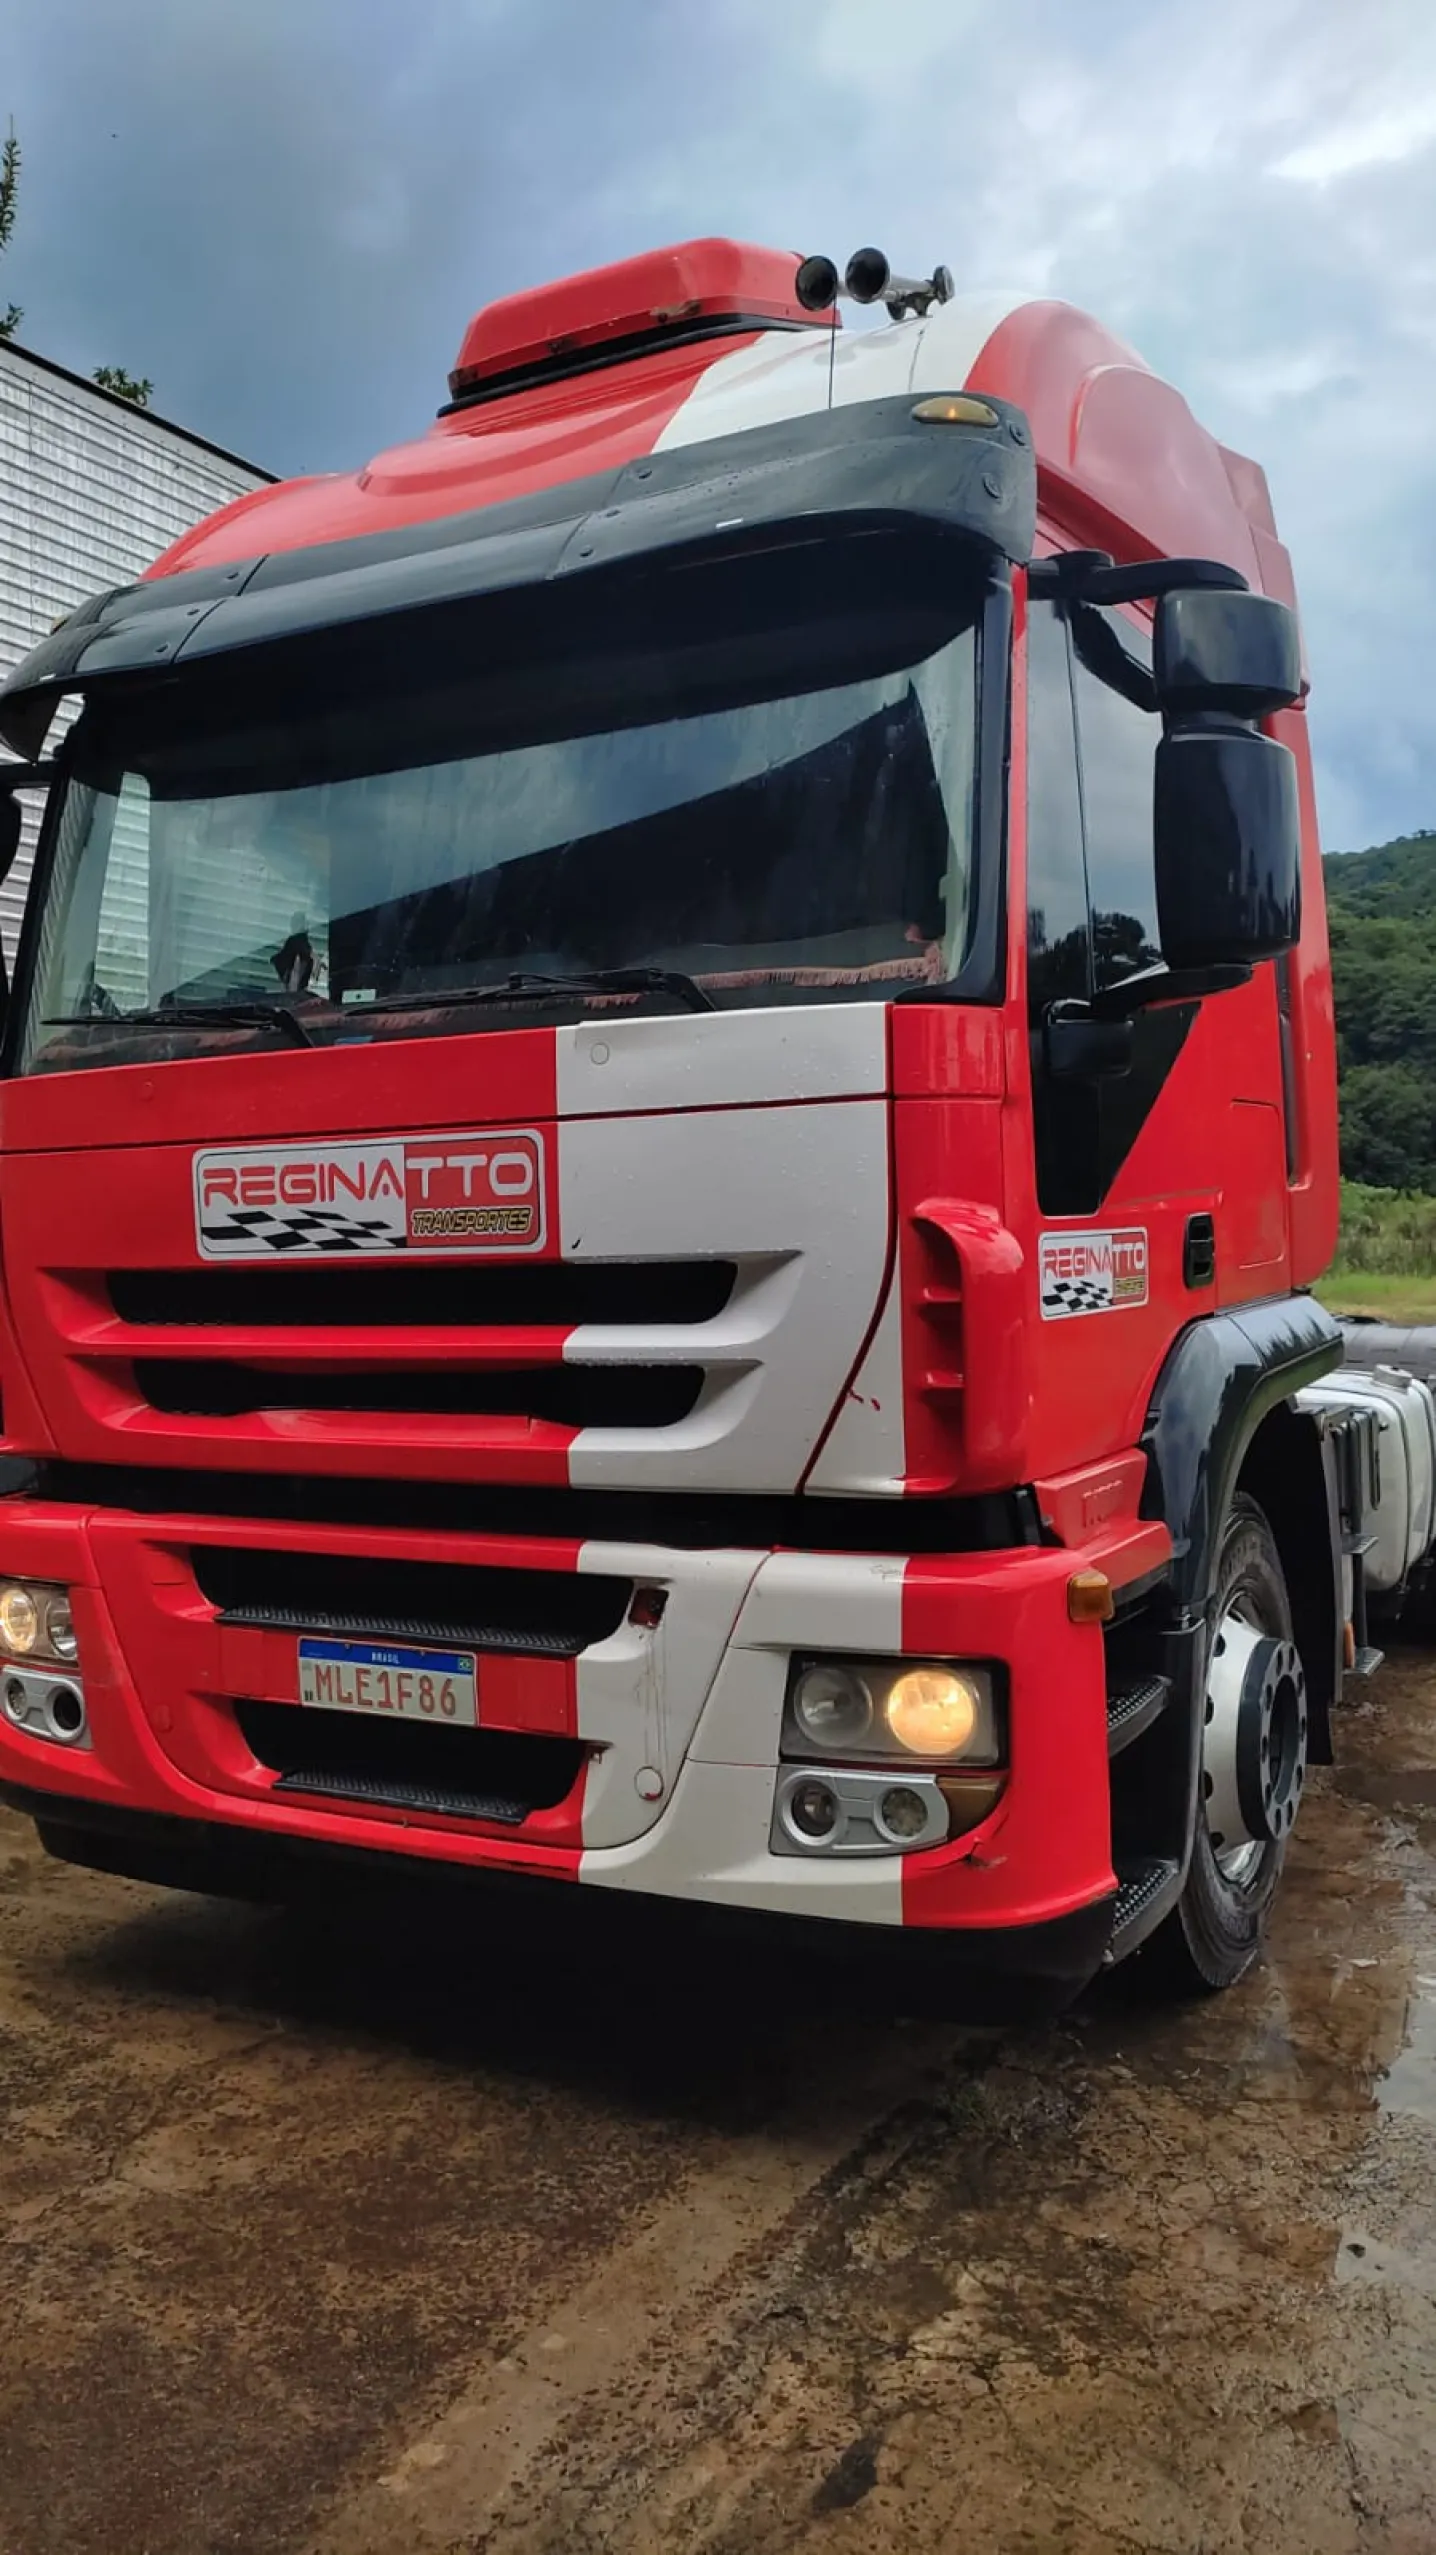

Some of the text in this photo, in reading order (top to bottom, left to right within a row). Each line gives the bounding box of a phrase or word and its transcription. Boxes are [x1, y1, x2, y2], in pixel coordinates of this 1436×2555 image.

[203, 1152, 534, 1207] REGINATTO
[411, 1206, 533, 1236] TRANSPORTES
[1043, 1242, 1145, 1279] REGINATTO
[314, 1664, 456, 1717] MLE1F86
